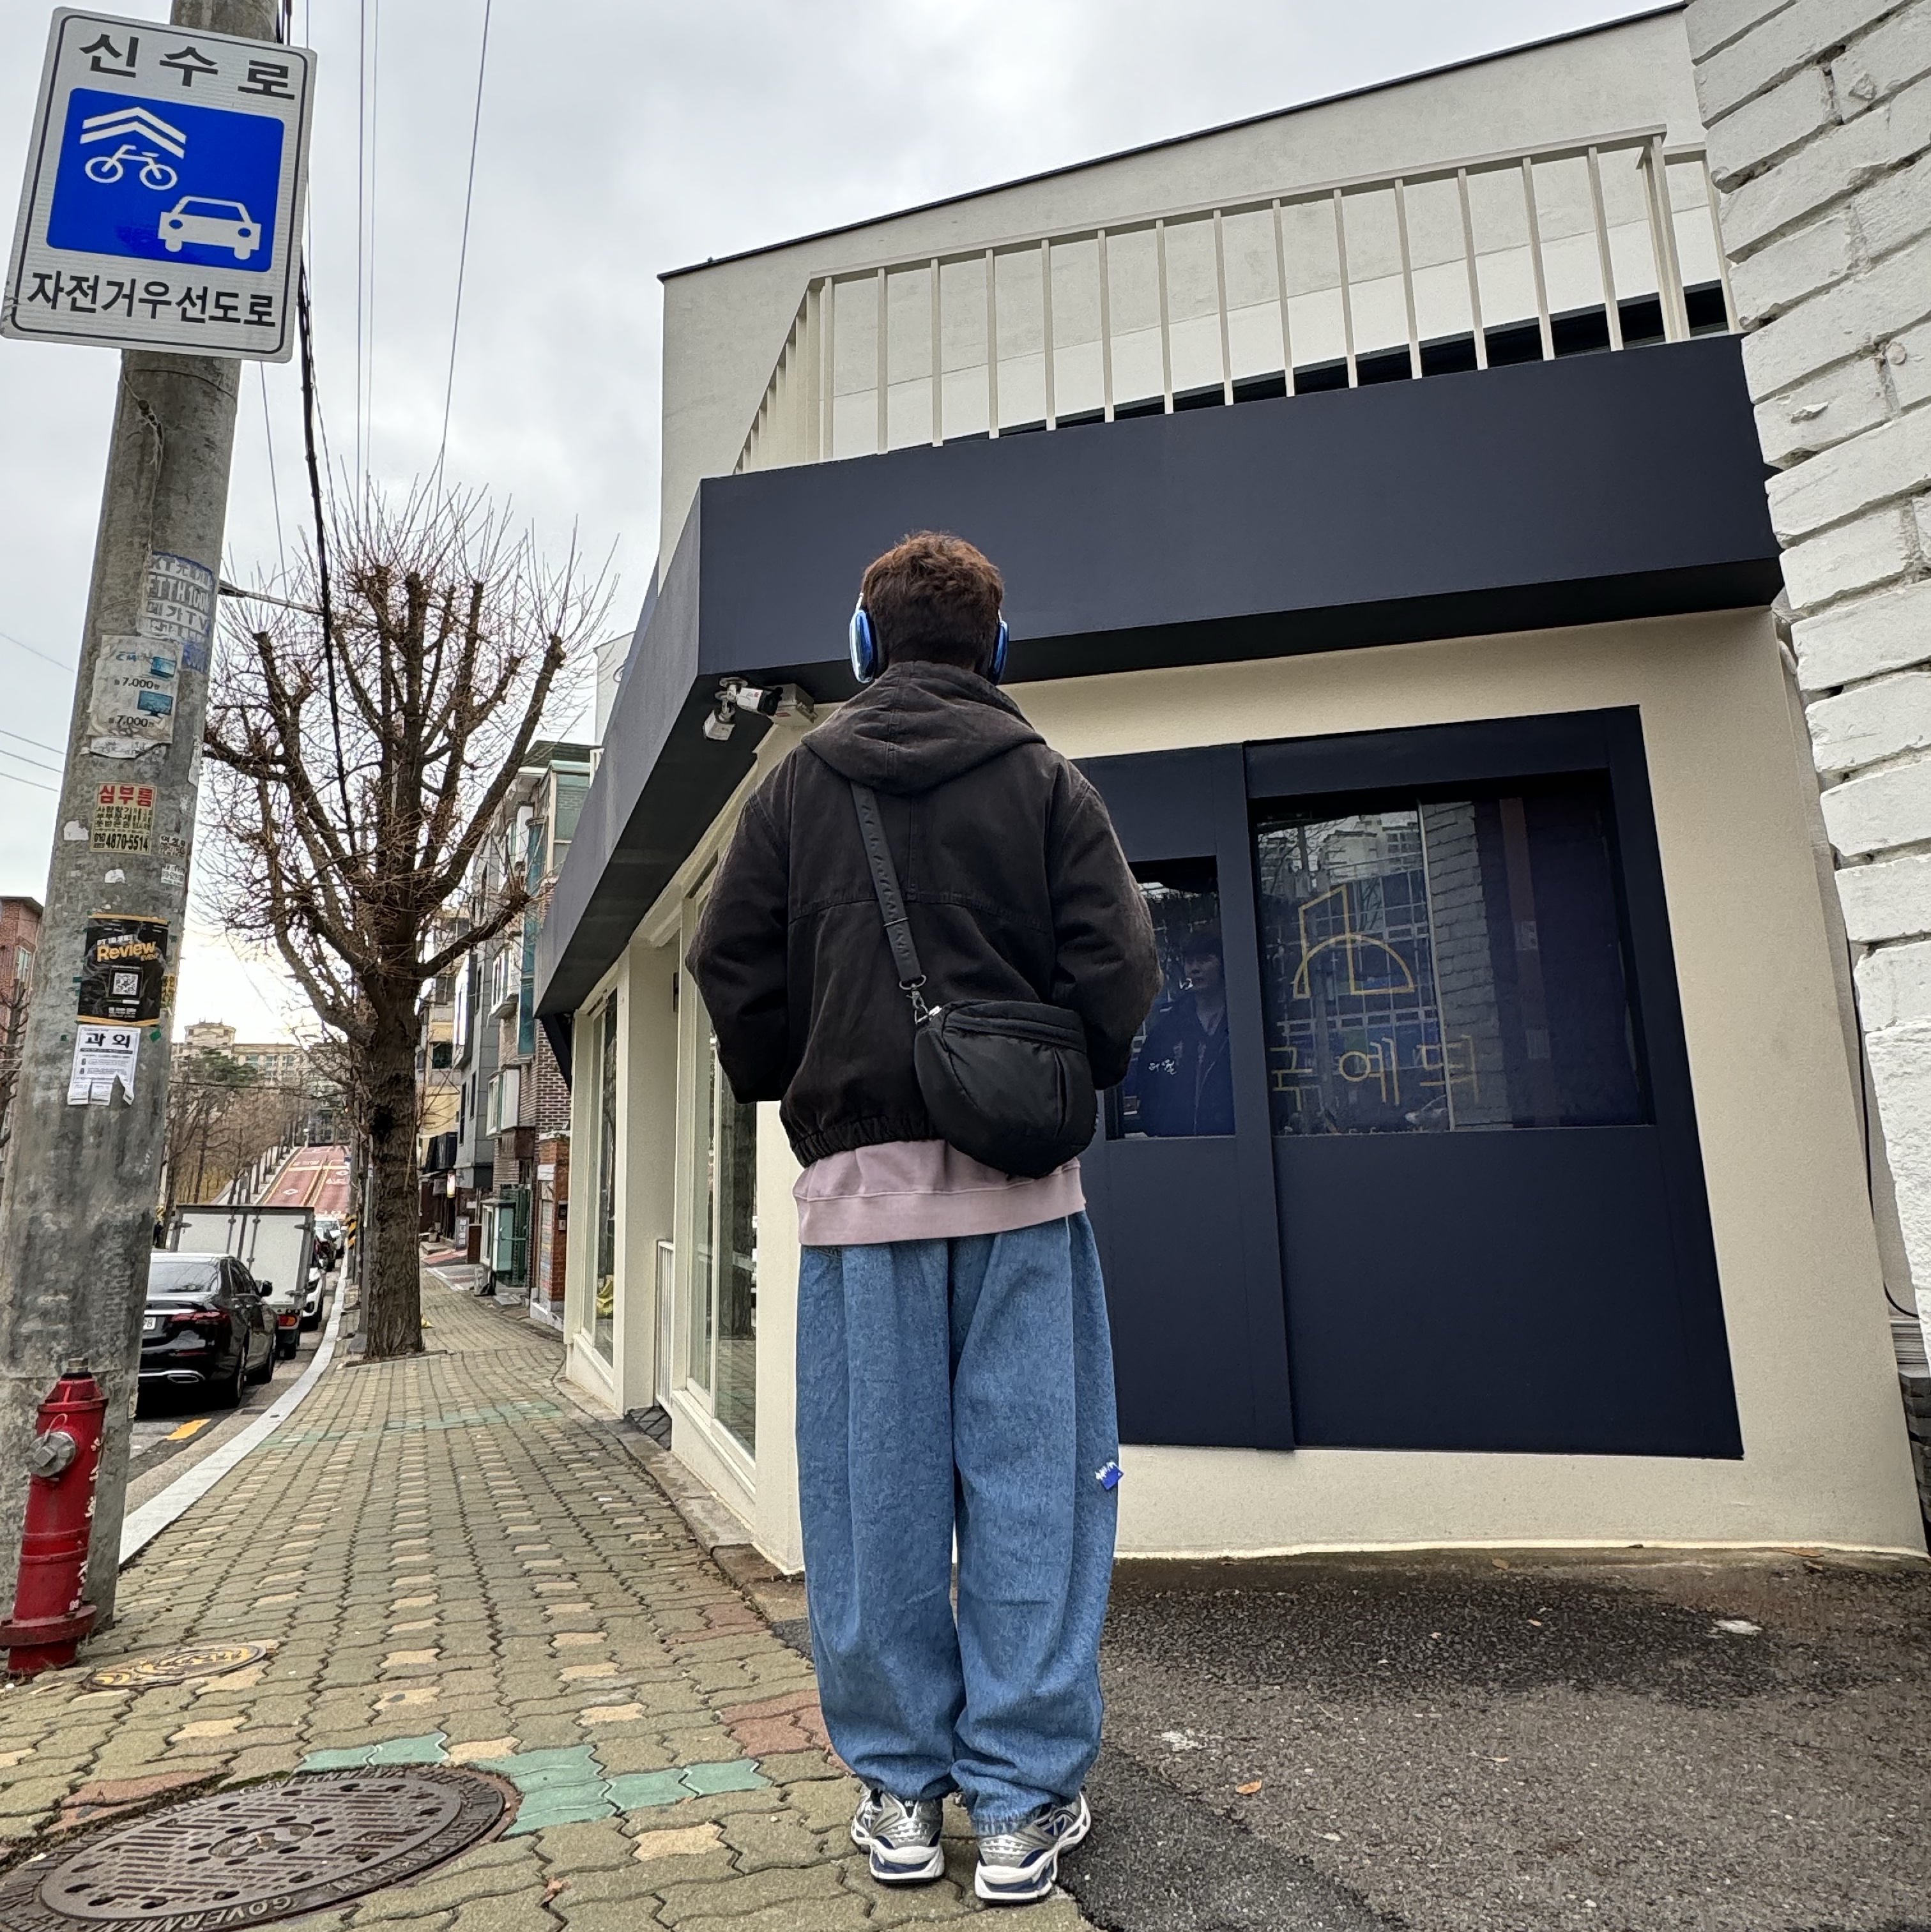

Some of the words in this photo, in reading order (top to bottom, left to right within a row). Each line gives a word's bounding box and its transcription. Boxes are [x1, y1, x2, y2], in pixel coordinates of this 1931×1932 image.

[79, 33, 295, 100] 신수로
[27, 270, 275, 327] 자전거우선도로
[98, 784, 153, 807] 심부름
[105, 833, 148, 852] 4870-5514
[96, 941, 156, 962] Review
[84, 1032, 131, 1049] 과외
